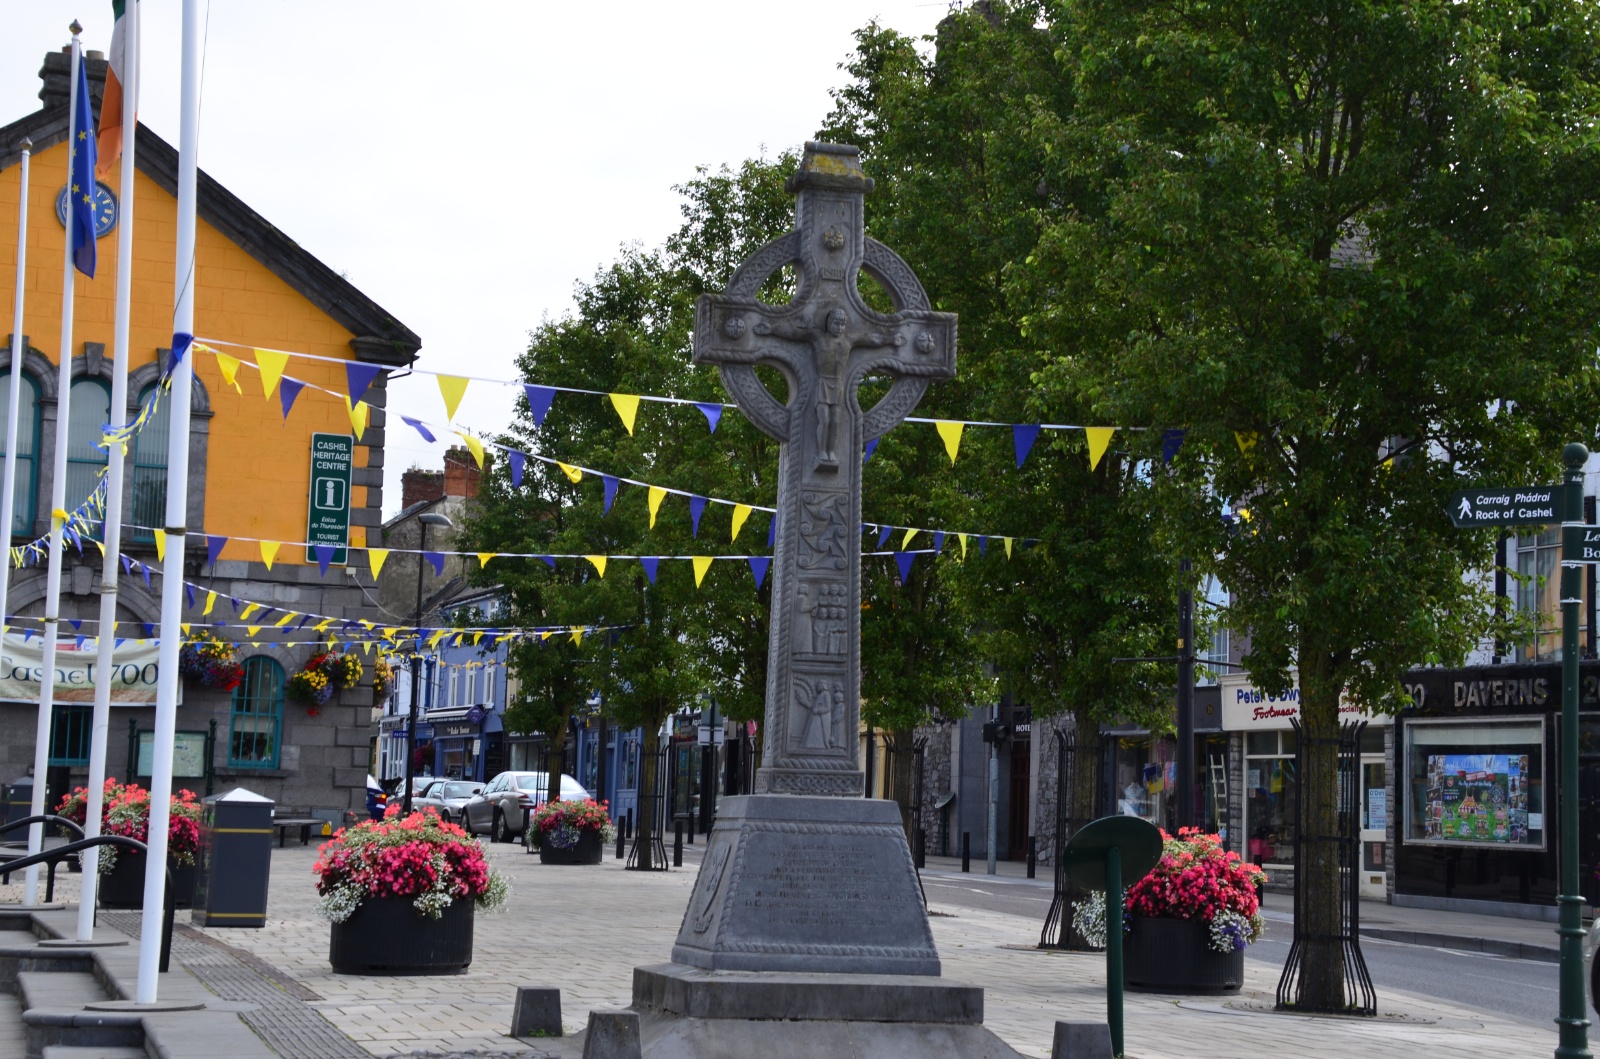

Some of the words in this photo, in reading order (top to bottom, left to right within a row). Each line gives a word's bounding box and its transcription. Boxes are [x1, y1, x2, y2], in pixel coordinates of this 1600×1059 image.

[317, 441, 348, 452] CASHEL
[313, 451, 351, 462] HERITAGE
[316, 461, 347, 471] CENTRE
[1476, 493, 1510, 505] Carraig
[1475, 510, 1500, 520] Rock
[1503, 509, 1514, 519] of
[1518, 507, 1553, 518] Cashel
[316, 533, 339, 541] TOURIST
[1453, 678, 1549, 707] DAVERNS
[1252, 700, 1297, 716] Footwear
